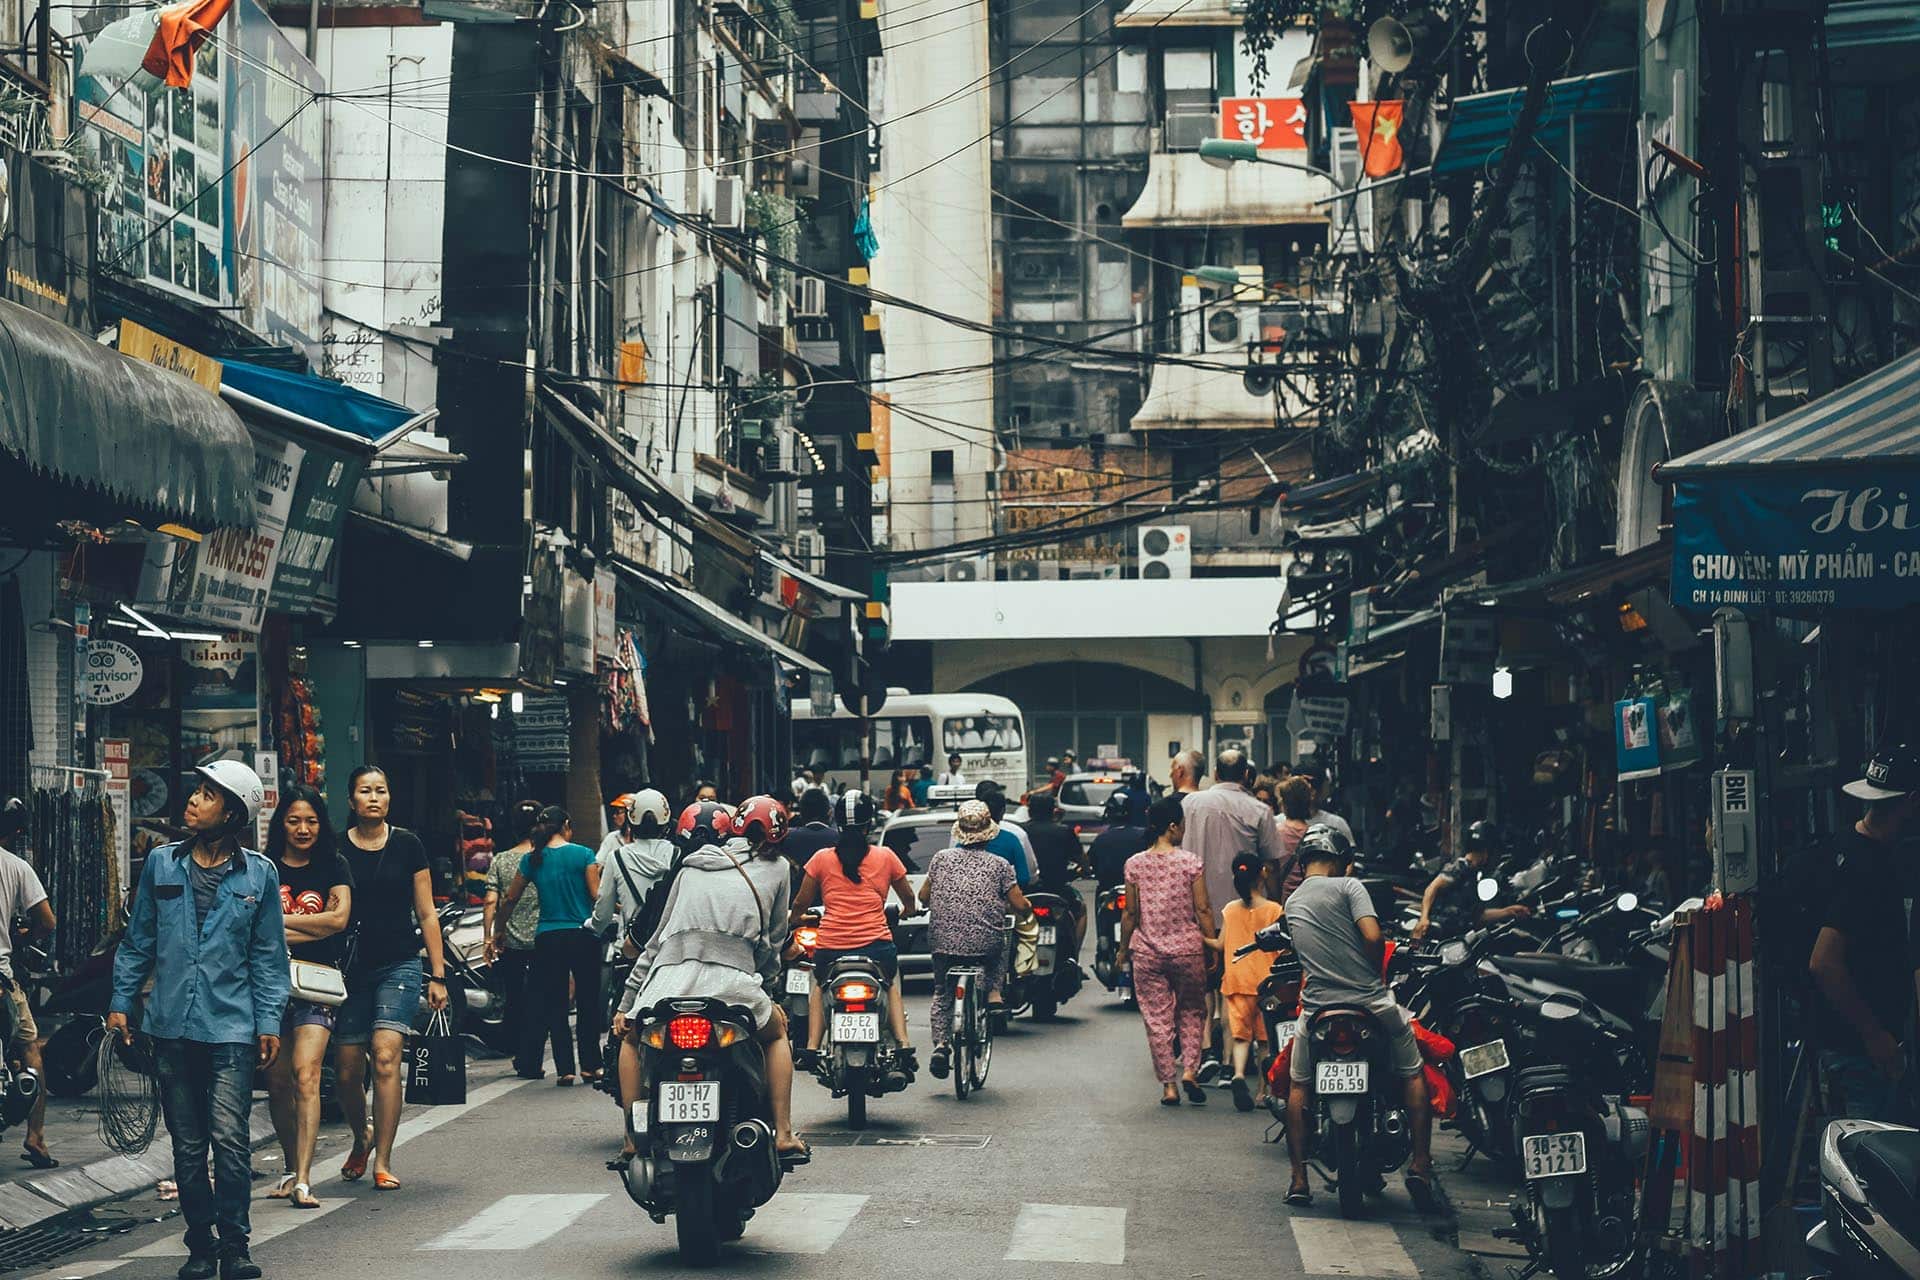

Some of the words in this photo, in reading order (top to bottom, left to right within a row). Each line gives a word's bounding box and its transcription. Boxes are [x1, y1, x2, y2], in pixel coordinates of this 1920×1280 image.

[1692, 550, 1772, 580] CHUYÊN:
[1778, 549, 1809, 580] MỸ
[1815, 542, 1874, 580] PHẨM
[1692, 589, 1707, 603] CH
[1710, 589, 1721, 603] 14
[190, 648, 242, 661] Island
[84, 669, 133, 681] advisor
[1726, 775, 1747, 811] BNE
[841, 1016, 871, 1027] 29-E2
[416, 1047, 429, 1087] SALE
[1319, 1078, 1364, 1092] 066.59
[668, 1085, 710, 1102] 30-H7
[668, 1103, 711, 1120] 1855
[693, 1127, 708, 1138] 68
[1533, 1154, 1577, 1174] 3121
